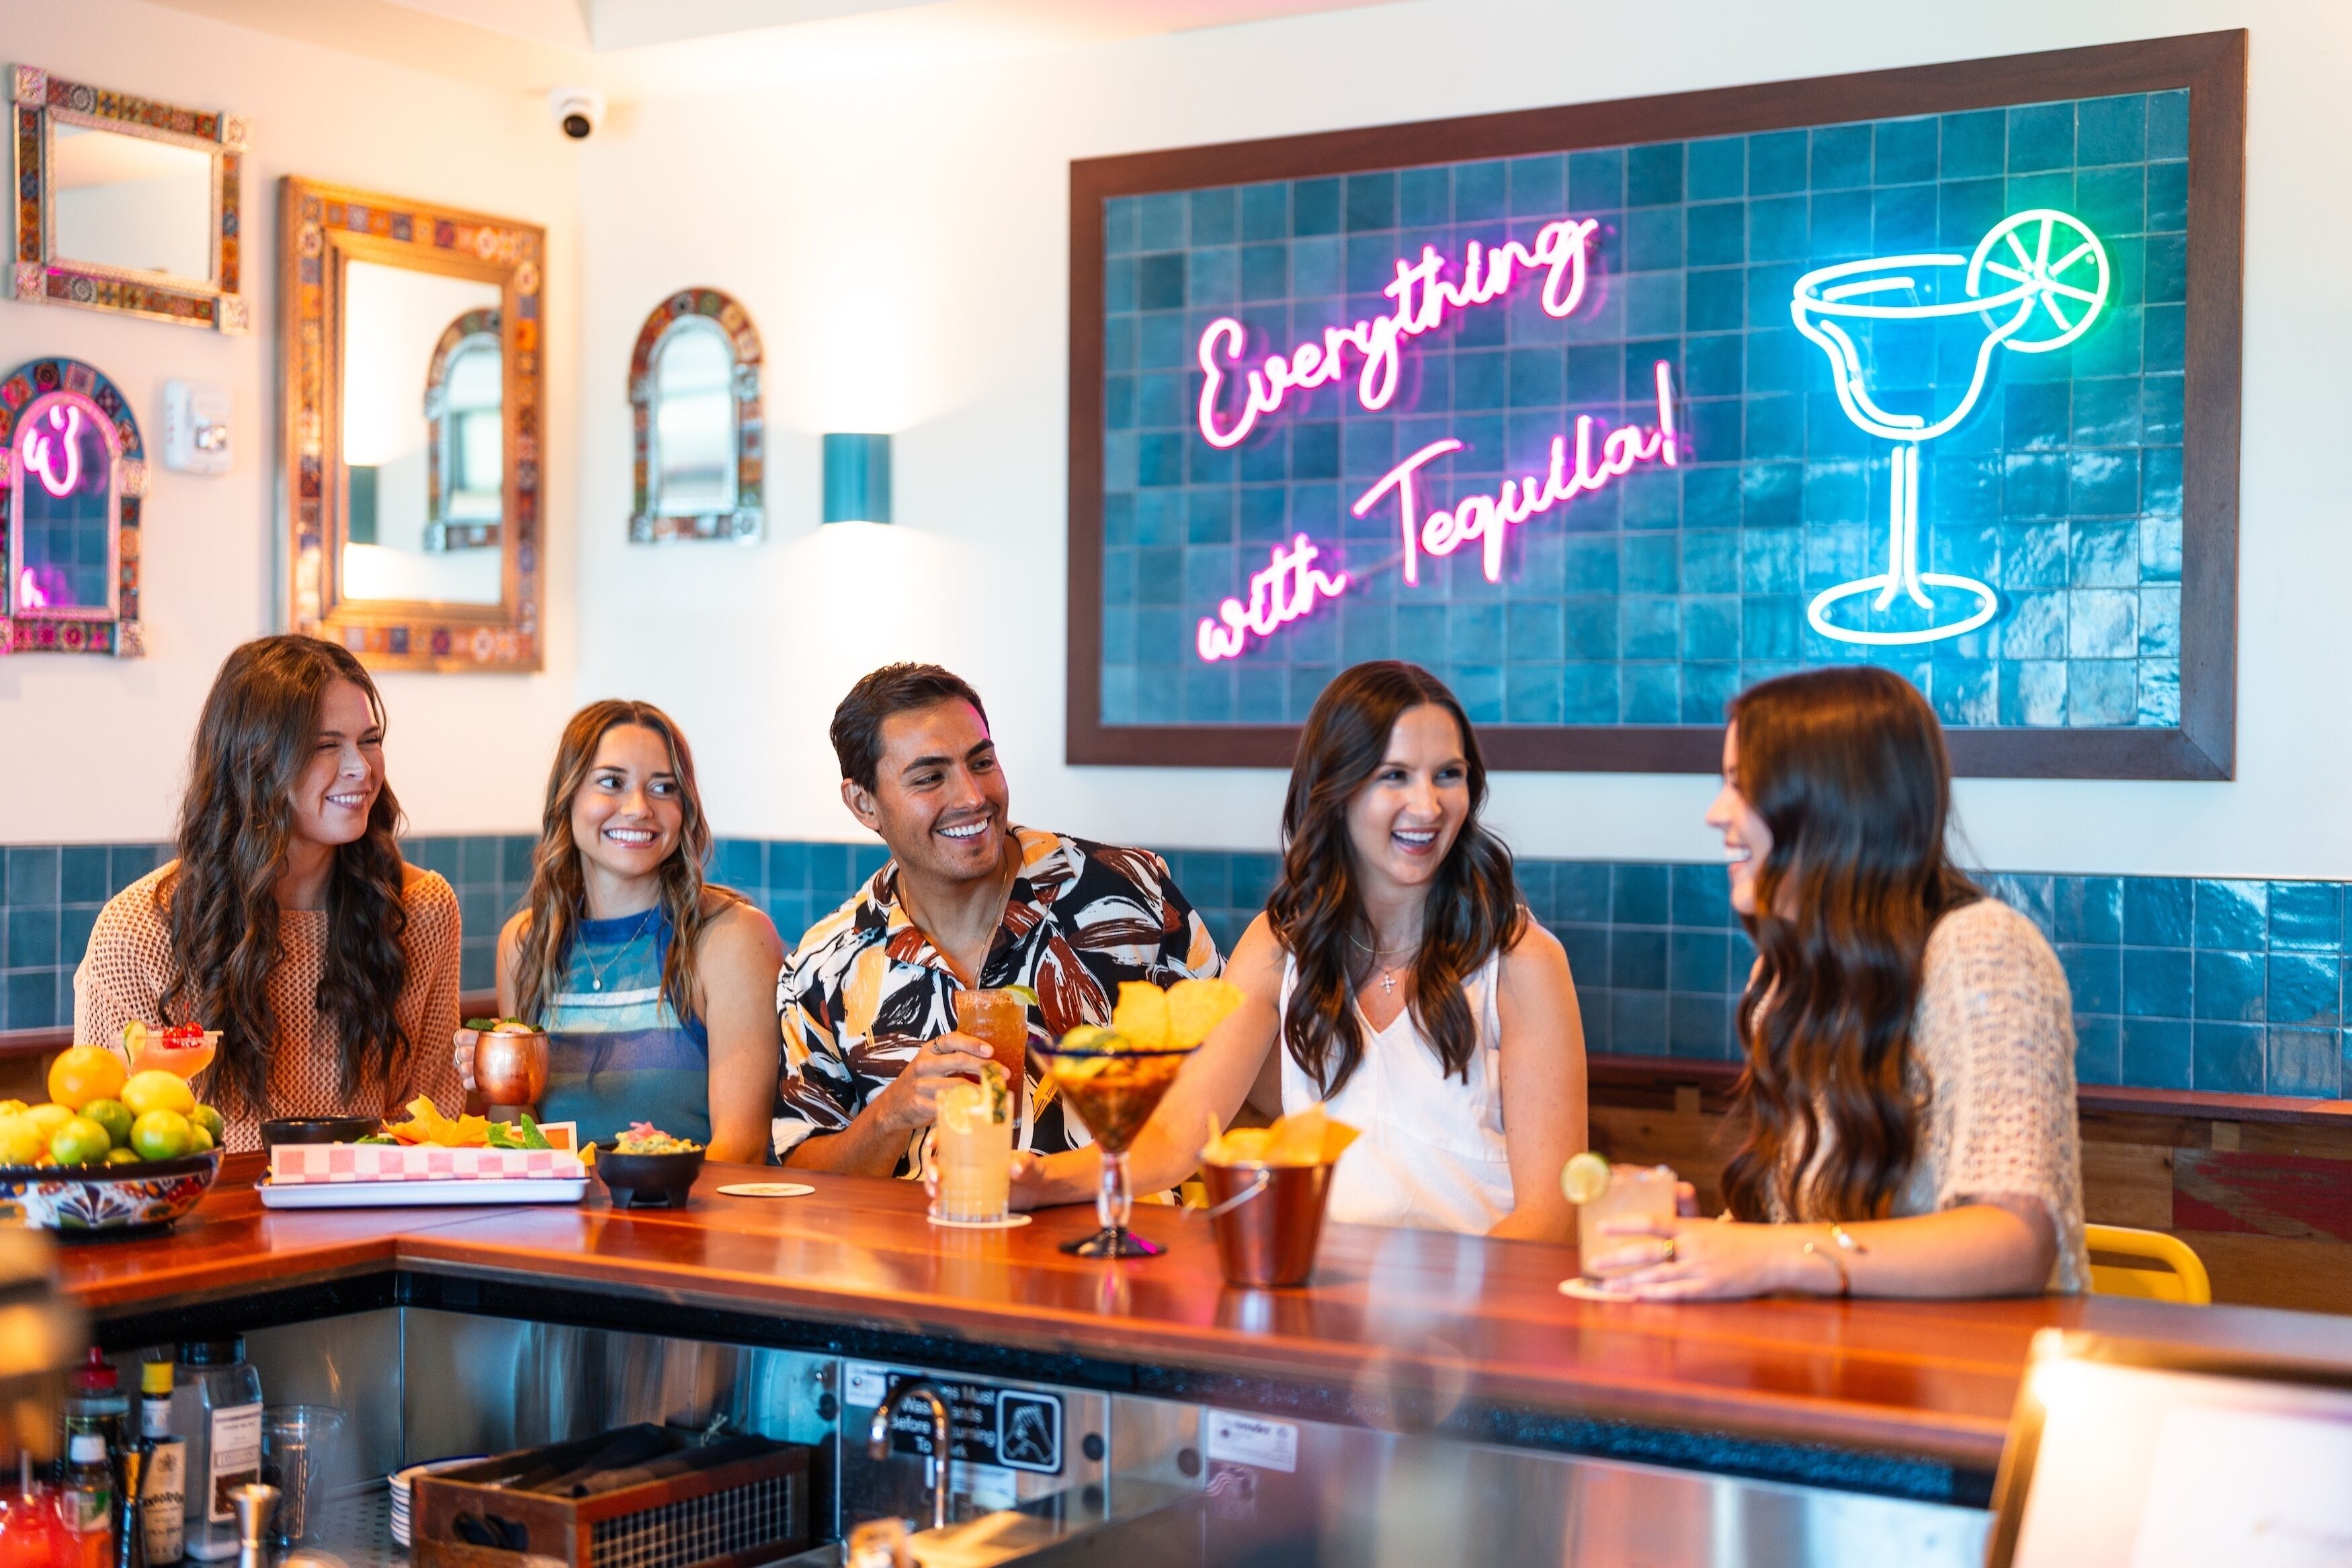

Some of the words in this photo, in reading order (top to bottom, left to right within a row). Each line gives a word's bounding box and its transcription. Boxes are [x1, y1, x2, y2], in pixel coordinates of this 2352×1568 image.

[1198, 218, 1599, 449] Everything
[1197, 531, 1347, 663] with
[1350, 359, 1677, 587] Tequila!
[900, 1395, 933, 1415] Was
[951, 1405, 983, 1424] ands
[962, 1385, 995, 1405] Must
[915, 1436, 933, 1454] To
